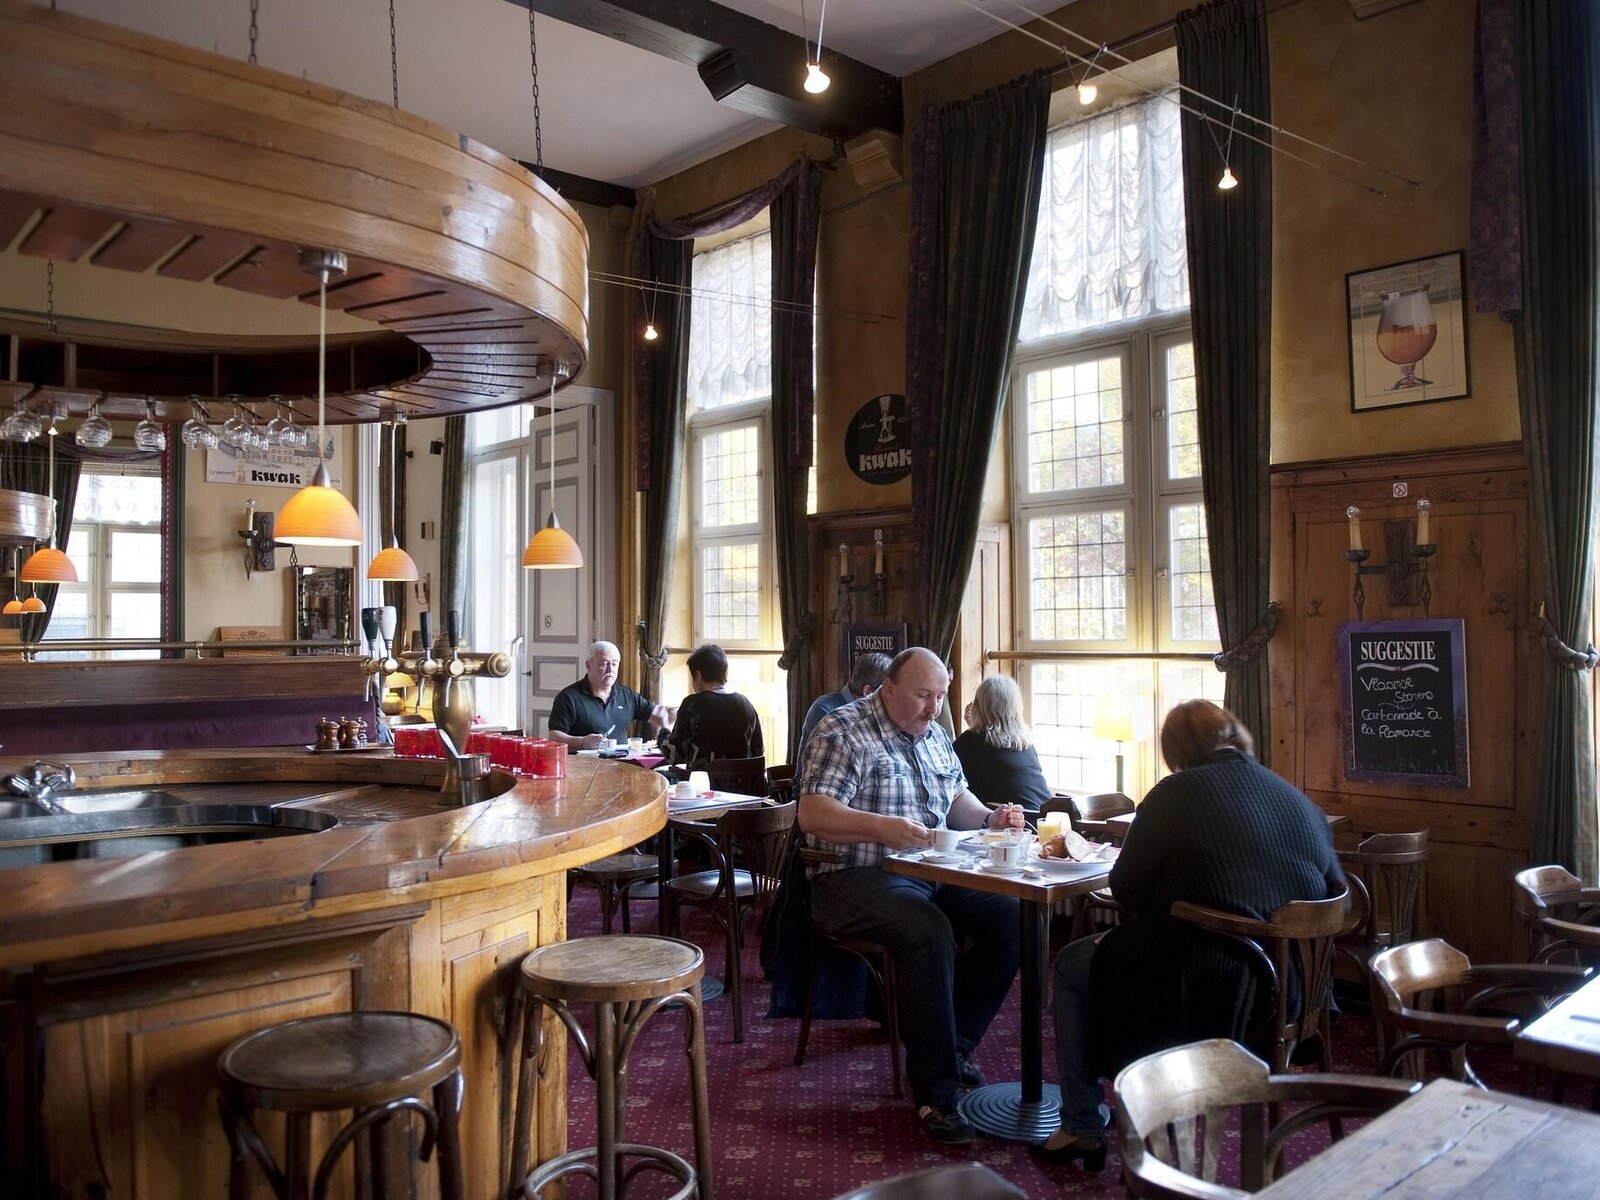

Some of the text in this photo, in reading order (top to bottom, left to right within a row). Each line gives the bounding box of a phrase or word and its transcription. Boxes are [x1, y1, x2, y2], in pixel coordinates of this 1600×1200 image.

[855, 635, 894, 650] SUGGESTIE
[1360, 640, 1436, 661] SUGGESTIE
[1361, 723, 1376, 736] la
